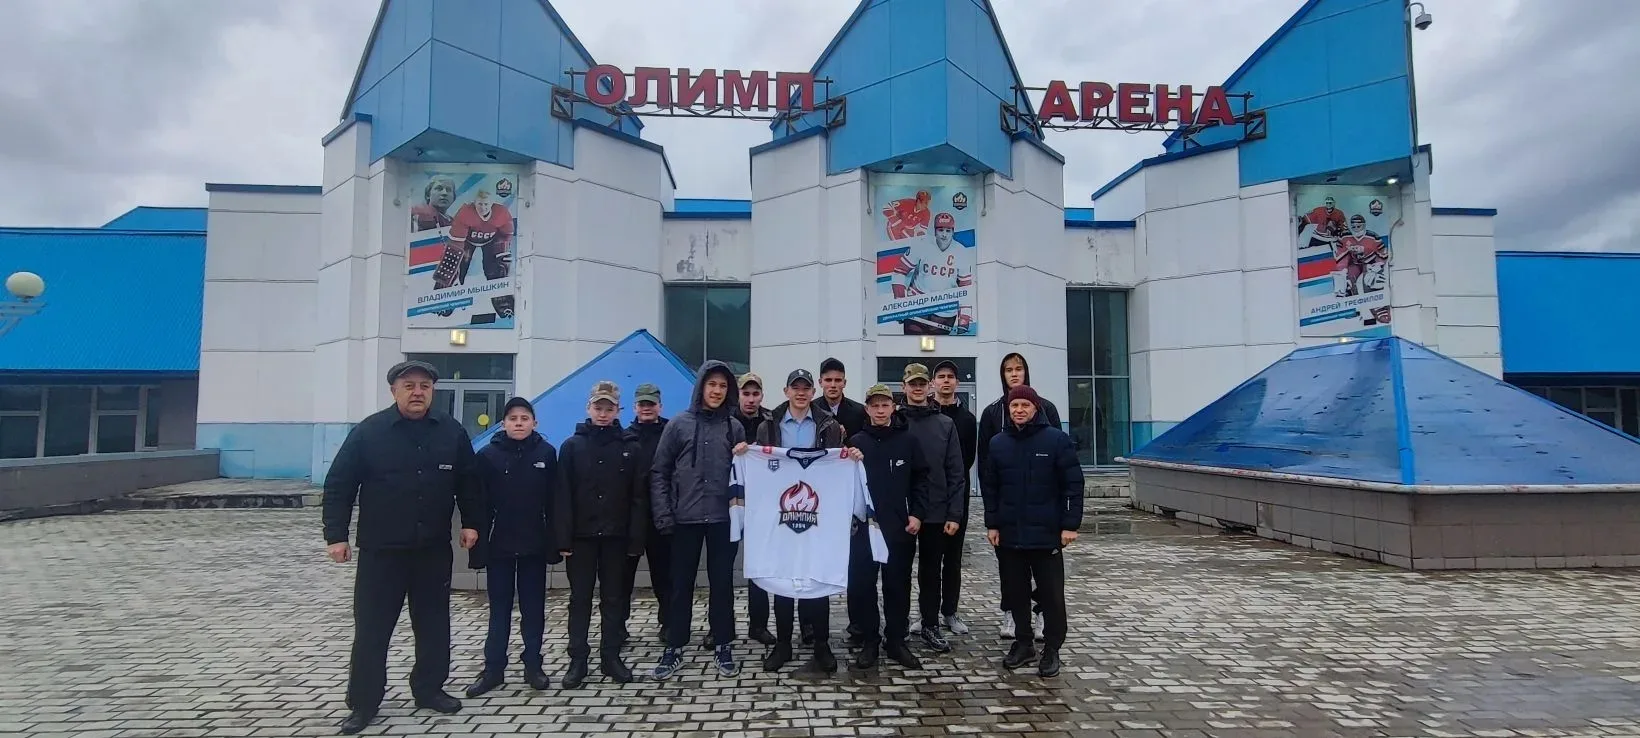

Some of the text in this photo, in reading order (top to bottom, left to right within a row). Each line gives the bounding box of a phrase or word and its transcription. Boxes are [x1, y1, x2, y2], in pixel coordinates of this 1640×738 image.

[585, 64, 1236, 125] ОЛИМП АРЕНА
[923, 263, 955, 277] СССР
[417, 282, 509, 304] ВЛАДИМИР МЫШКИН
[882, 297, 929, 312] АЛЕКСАНДР
[930, 289, 968, 303] МАЛЬЦЕВ
[1310, 293, 1384, 314] АНДРЕЙ ТРЕФИЛОВ
[782, 511, 816, 523] ОЛИМПИЯ
